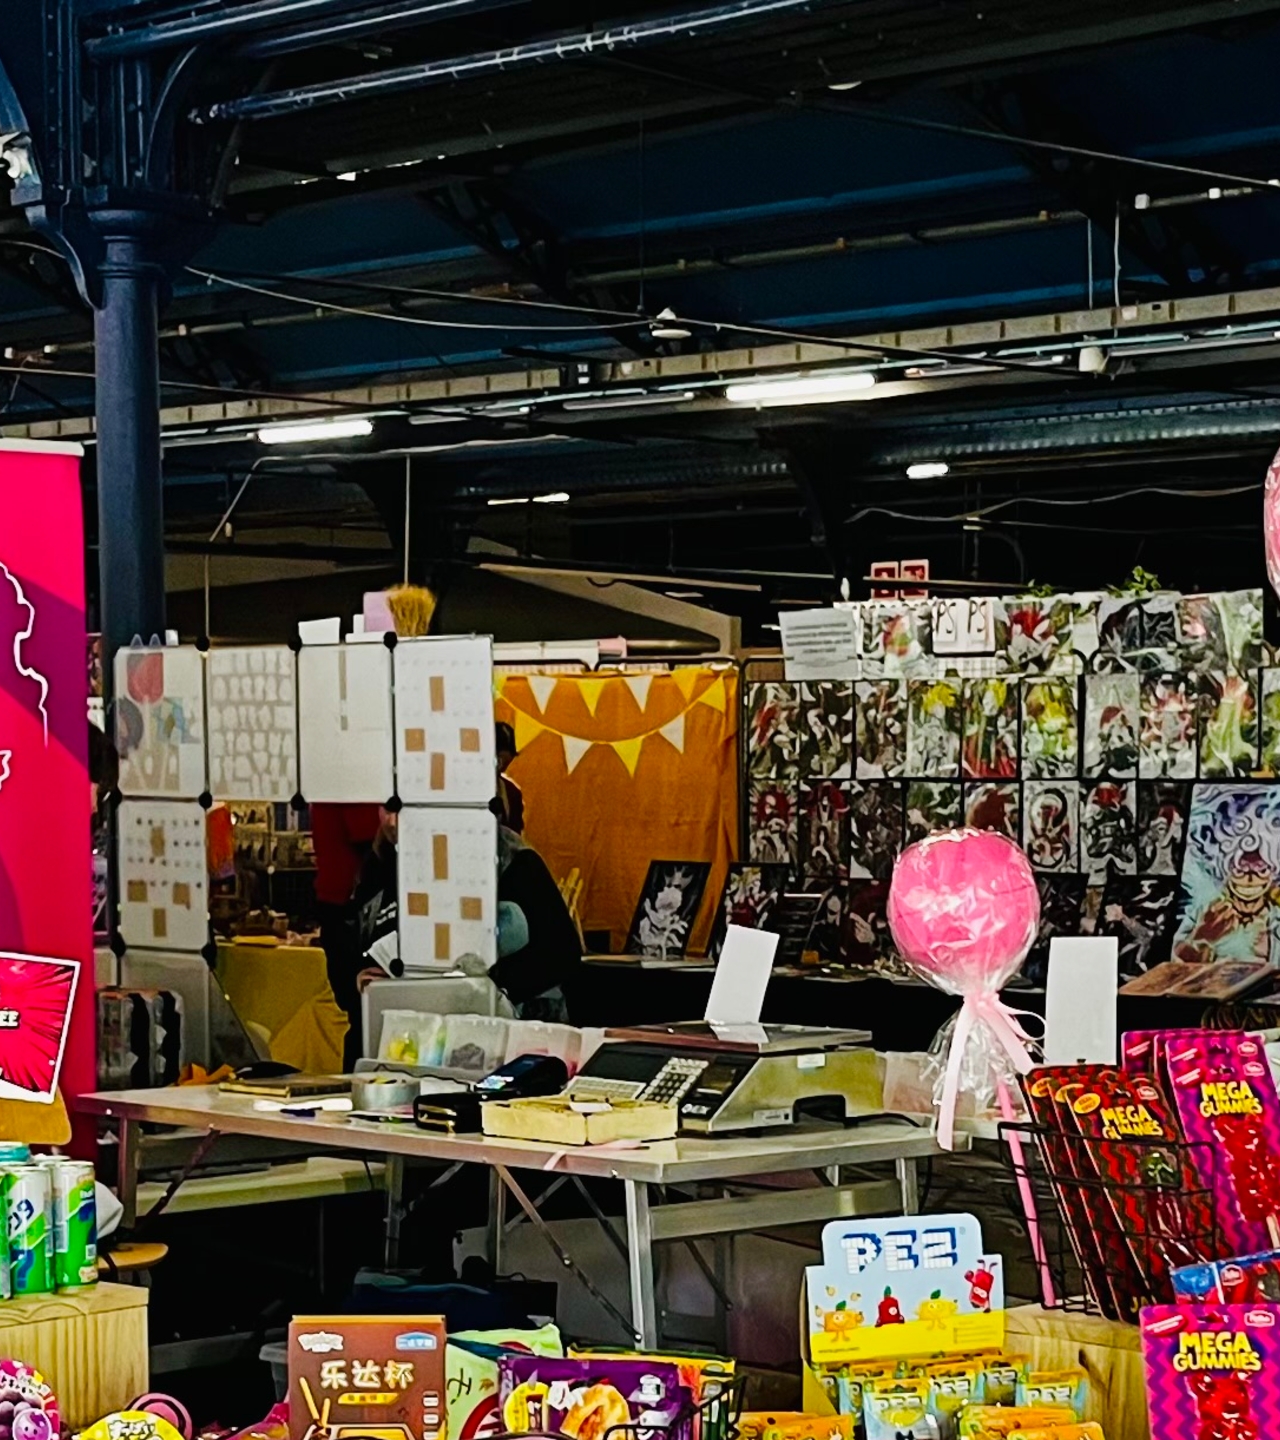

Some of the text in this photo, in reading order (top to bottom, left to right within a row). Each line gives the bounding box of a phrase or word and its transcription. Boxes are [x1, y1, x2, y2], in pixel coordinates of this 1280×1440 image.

[1200, 1080, 1255, 1102] MEGA
[1100, 1103, 1152, 1127] MEGA
[1200, 1098, 1263, 1118] GUMMIES
[841, 1227, 958, 1275] PEZ
[1179, 1331, 1252, 1354] MEGA
[1173, 1350, 1262, 1372] GUMMIES
